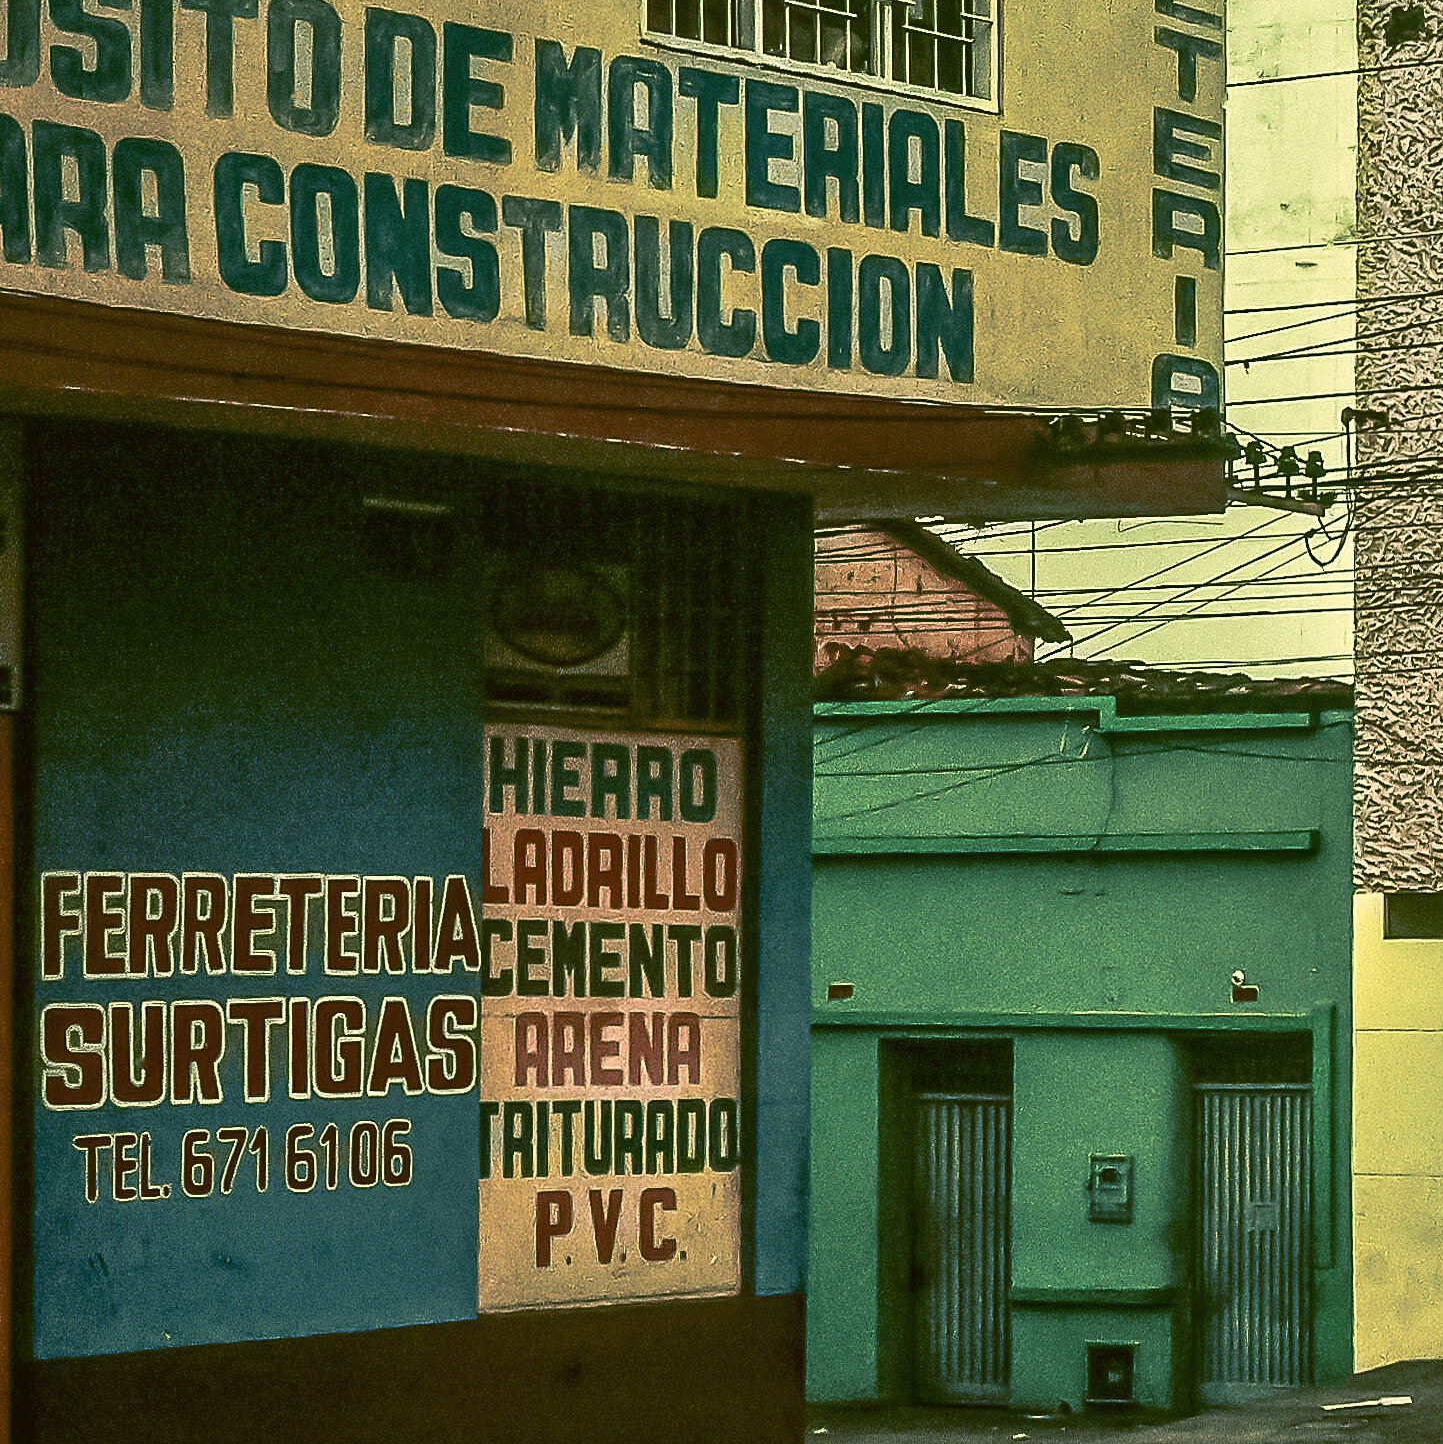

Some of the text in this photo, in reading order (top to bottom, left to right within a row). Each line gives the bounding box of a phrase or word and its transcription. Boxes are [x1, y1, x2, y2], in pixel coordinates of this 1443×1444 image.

[364, 5, 512, 164] DE
[534, 36, 1100, 266] MATERIALES
[213, 152, 975, 384] CONSTRUCCION
[488, 736, 717, 824] HIERRO
[482, 828, 738, 913] LADRILLO
[40, 871, 480, 980] FERRETERIA
[482, 919, 737, 1001] CEMENTO
[40, 996, 479, 1110] SURTIGAS
[514, 1012, 703, 1088] ARENA
[74, 1119, 414, 1205] TEL. 671 6106
[479, 1099, 739, 1180] TRITURADO
